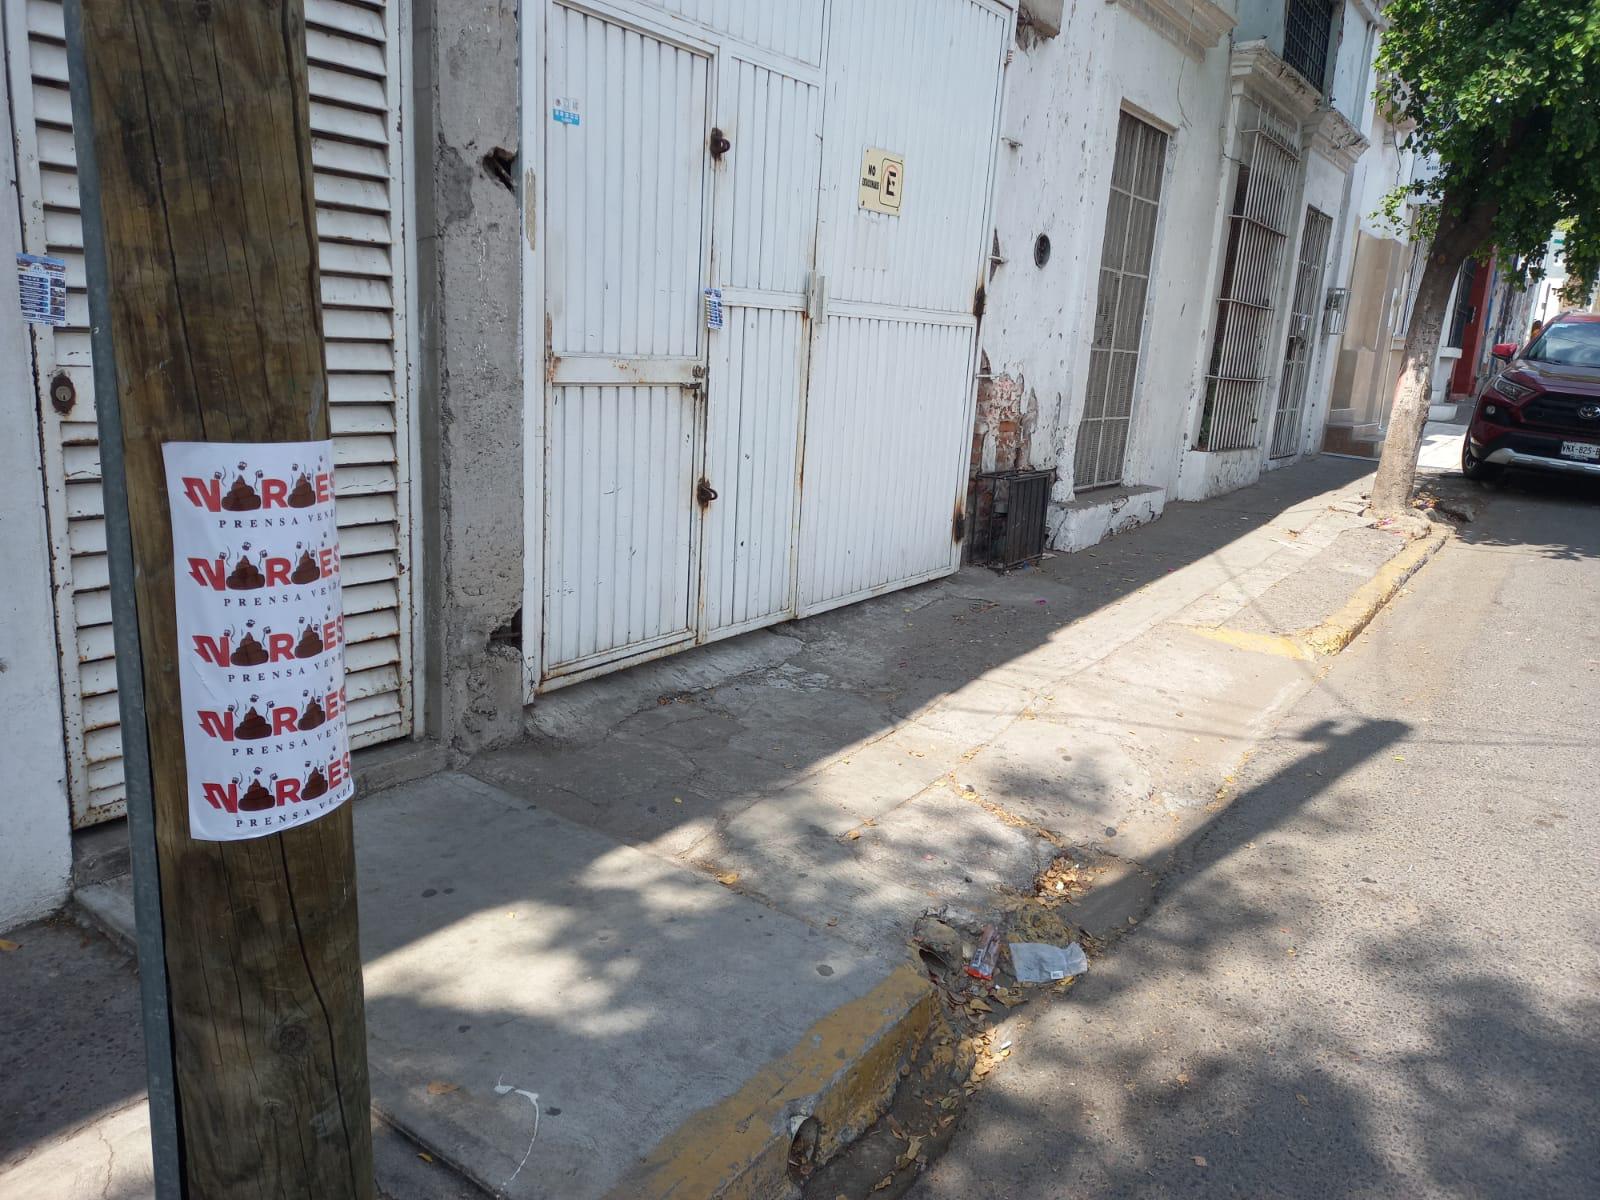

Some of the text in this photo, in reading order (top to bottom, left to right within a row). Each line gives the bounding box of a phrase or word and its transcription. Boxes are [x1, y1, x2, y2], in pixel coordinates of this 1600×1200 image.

[867, 164, 877, 177] NO
[886, 171, 897, 197] E
[218, 517, 299, 529] PRENSA
[223, 593, 302, 607] PRENSA
[228, 668, 305, 682] PRENSA
[232, 740, 308, 756] PRENSA
[236, 809, 311, 828] PRENSA
